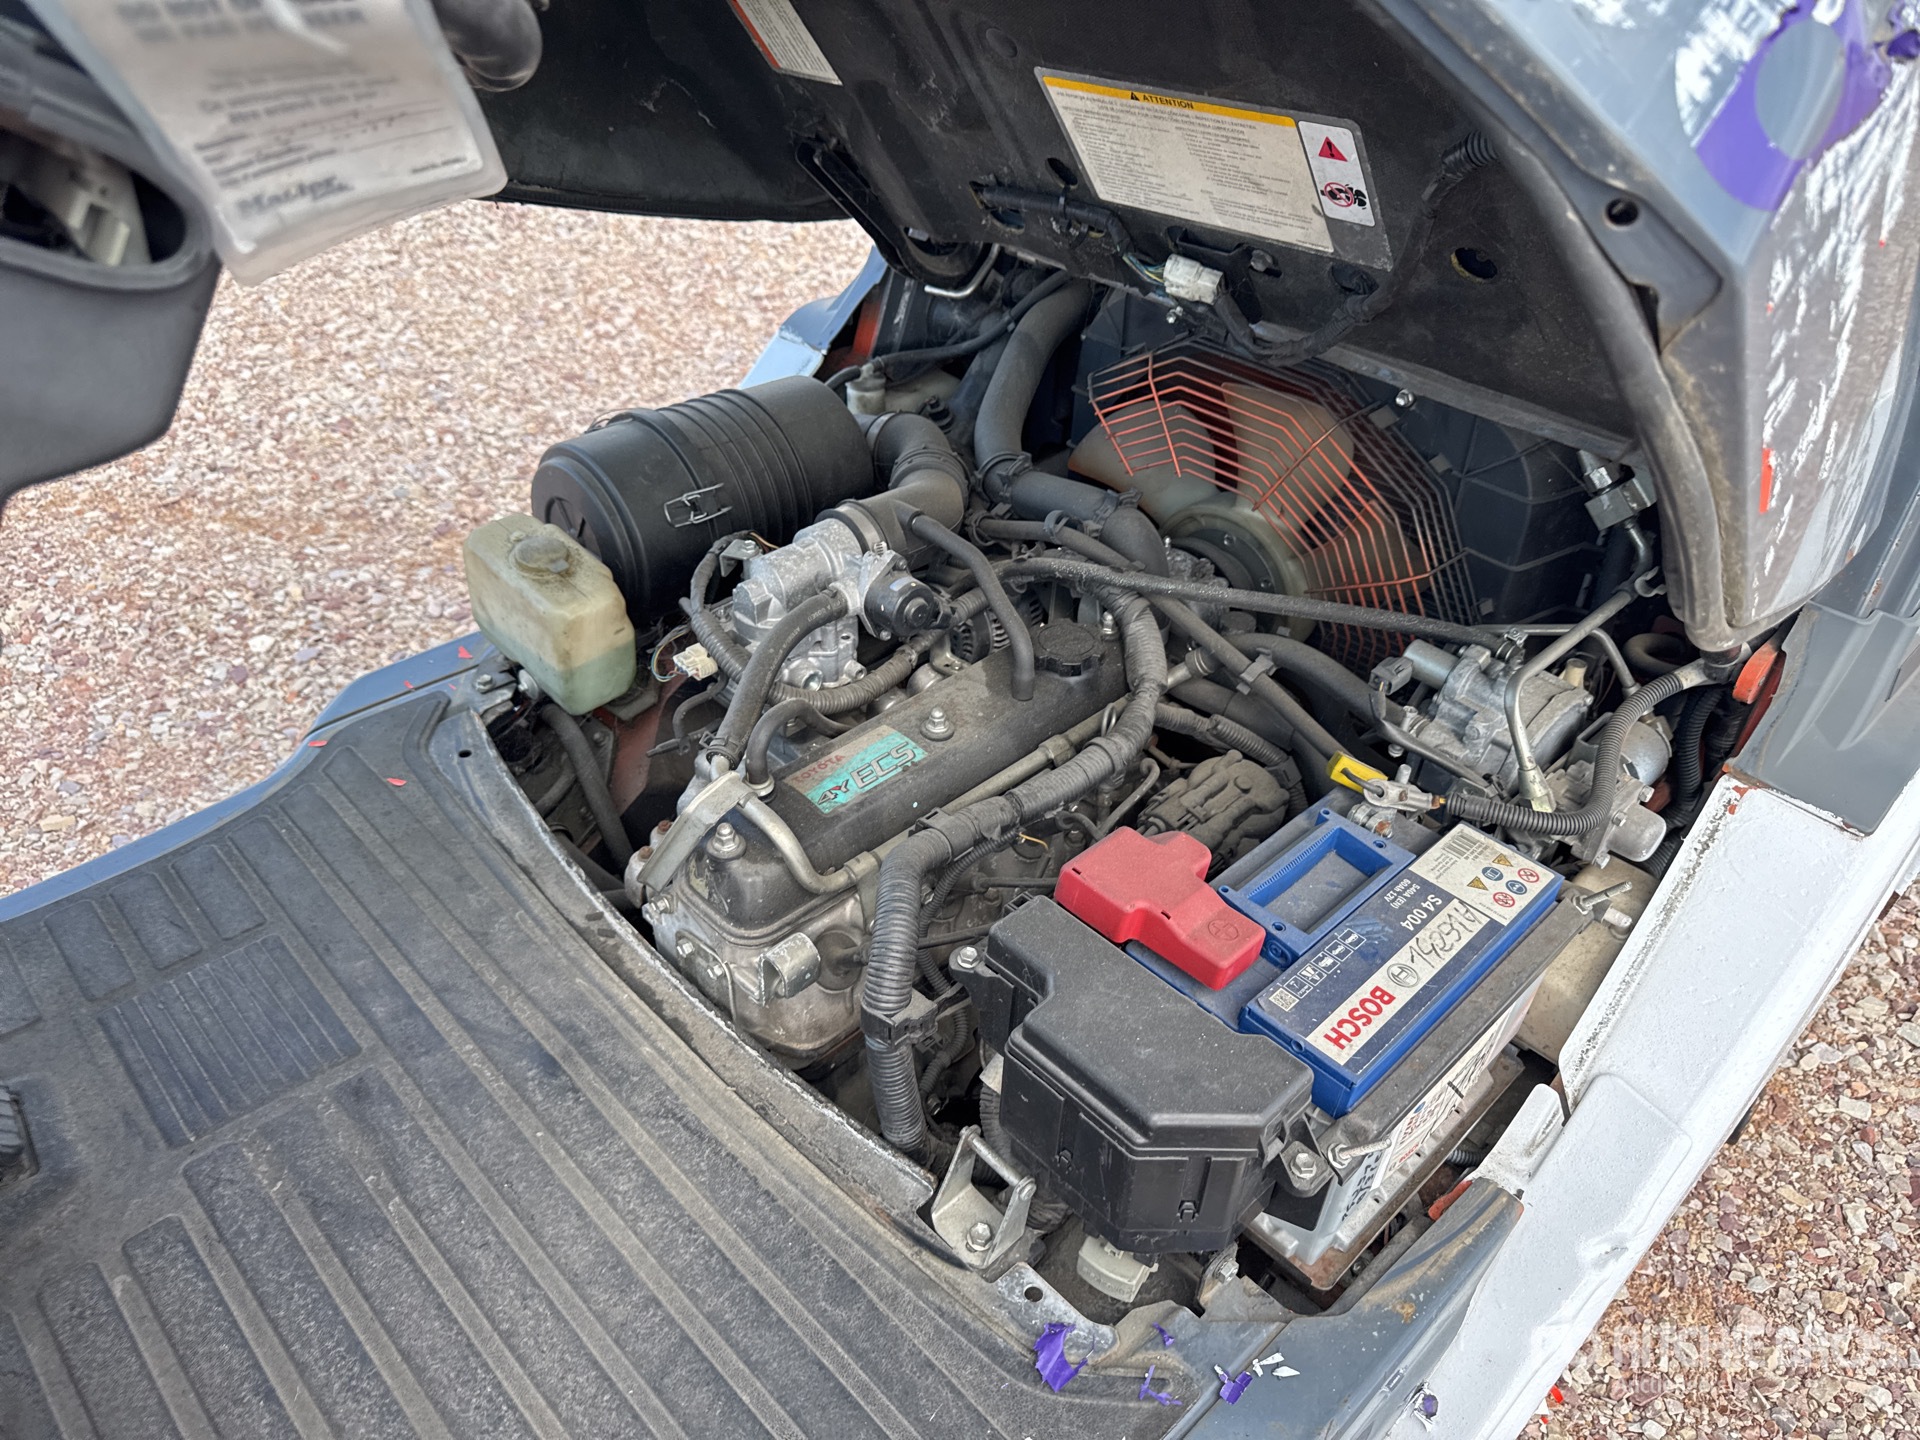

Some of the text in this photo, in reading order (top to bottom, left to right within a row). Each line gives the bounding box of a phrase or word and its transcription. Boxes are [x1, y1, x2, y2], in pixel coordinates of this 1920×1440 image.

[1142, 94, 1194, 110] ATTENTION
[792, 753, 846, 785] TOYOTA
[817, 741, 917, 806] 4Y ECS
[1384, 878, 1412, 903] 60Ah 12V
[1402, 883, 1421, 898] 540A
[1399, 893, 1443, 932] S4 004
[1323, 985, 1397, 1051] BOSCH
